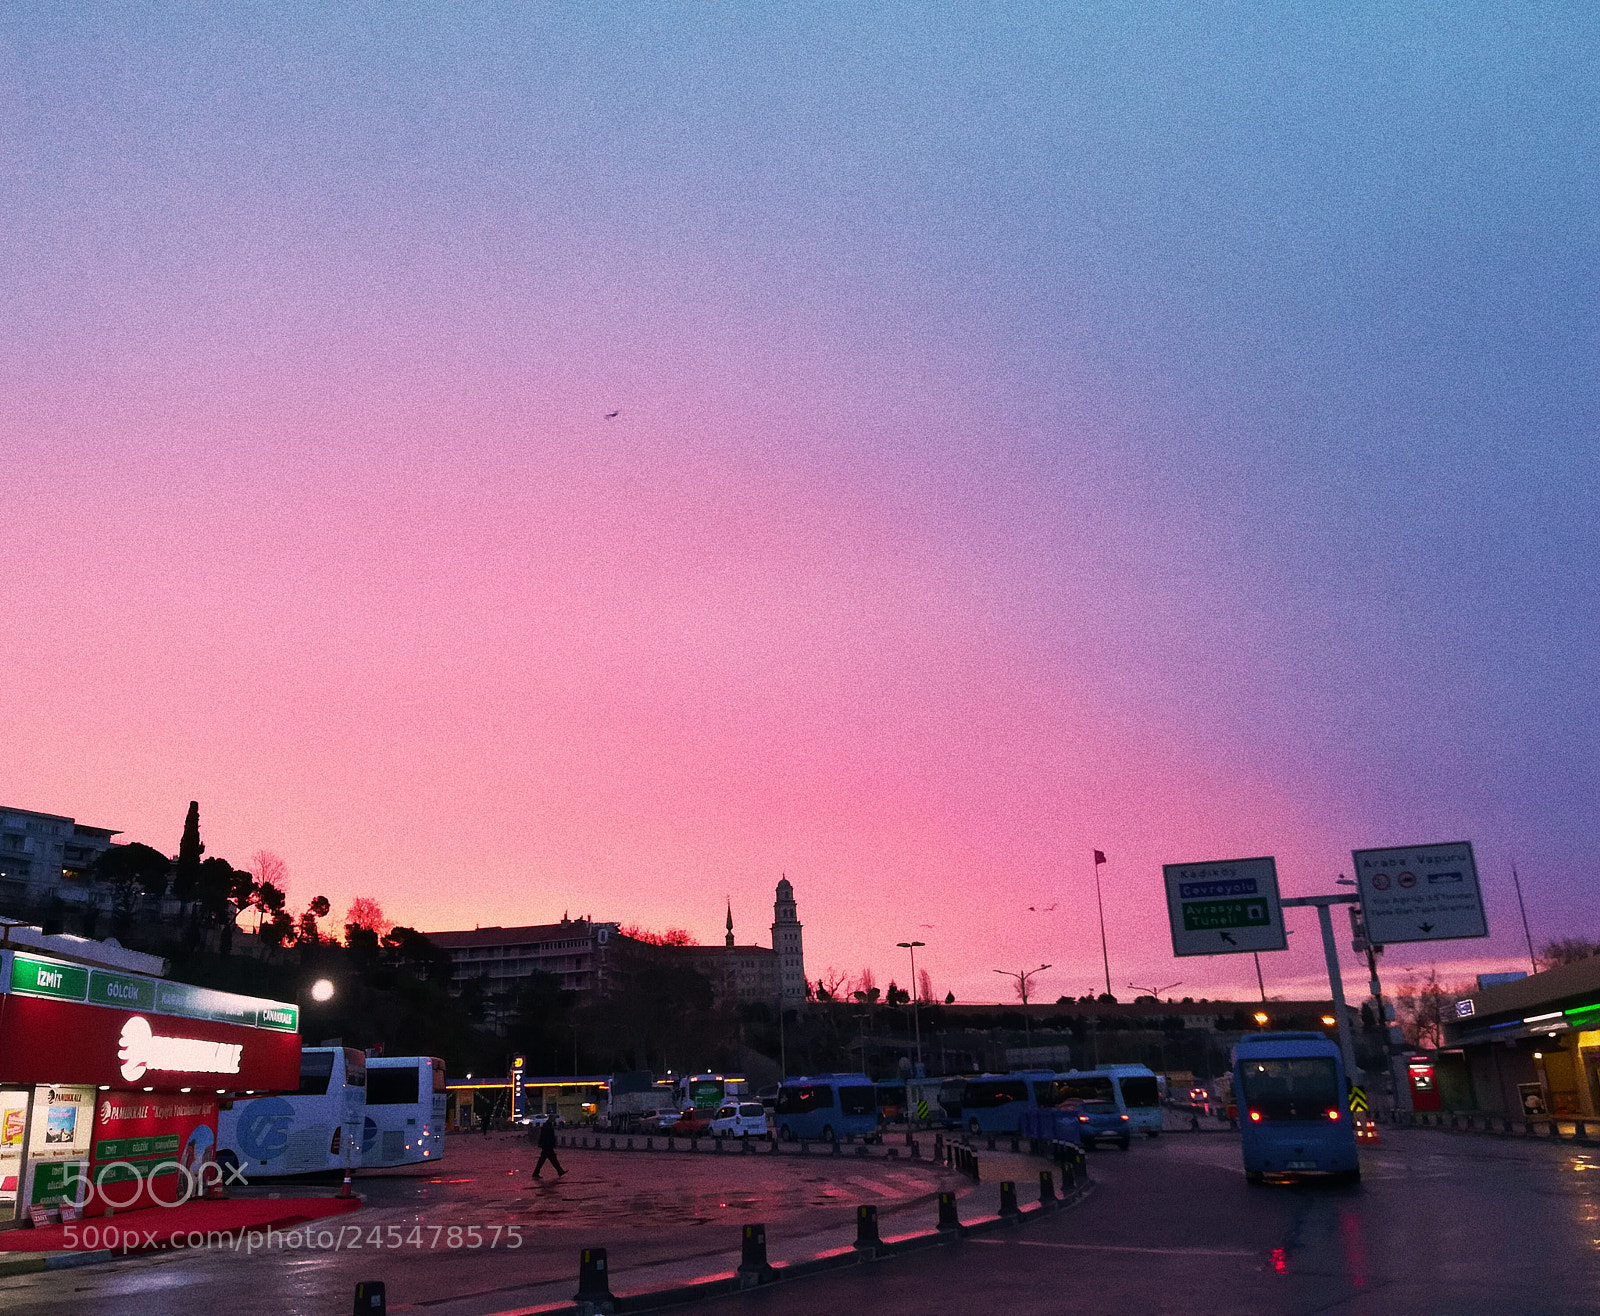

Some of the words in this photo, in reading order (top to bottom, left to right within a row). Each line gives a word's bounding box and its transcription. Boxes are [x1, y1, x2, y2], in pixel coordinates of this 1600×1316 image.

[1186, 903, 1242, 915] Avrasya
[37, 967, 63, 989] İZMİT
[107, 981, 139, 1000] GÖLCÜK
[110, 1105, 149, 1120] PAMUKKALE
